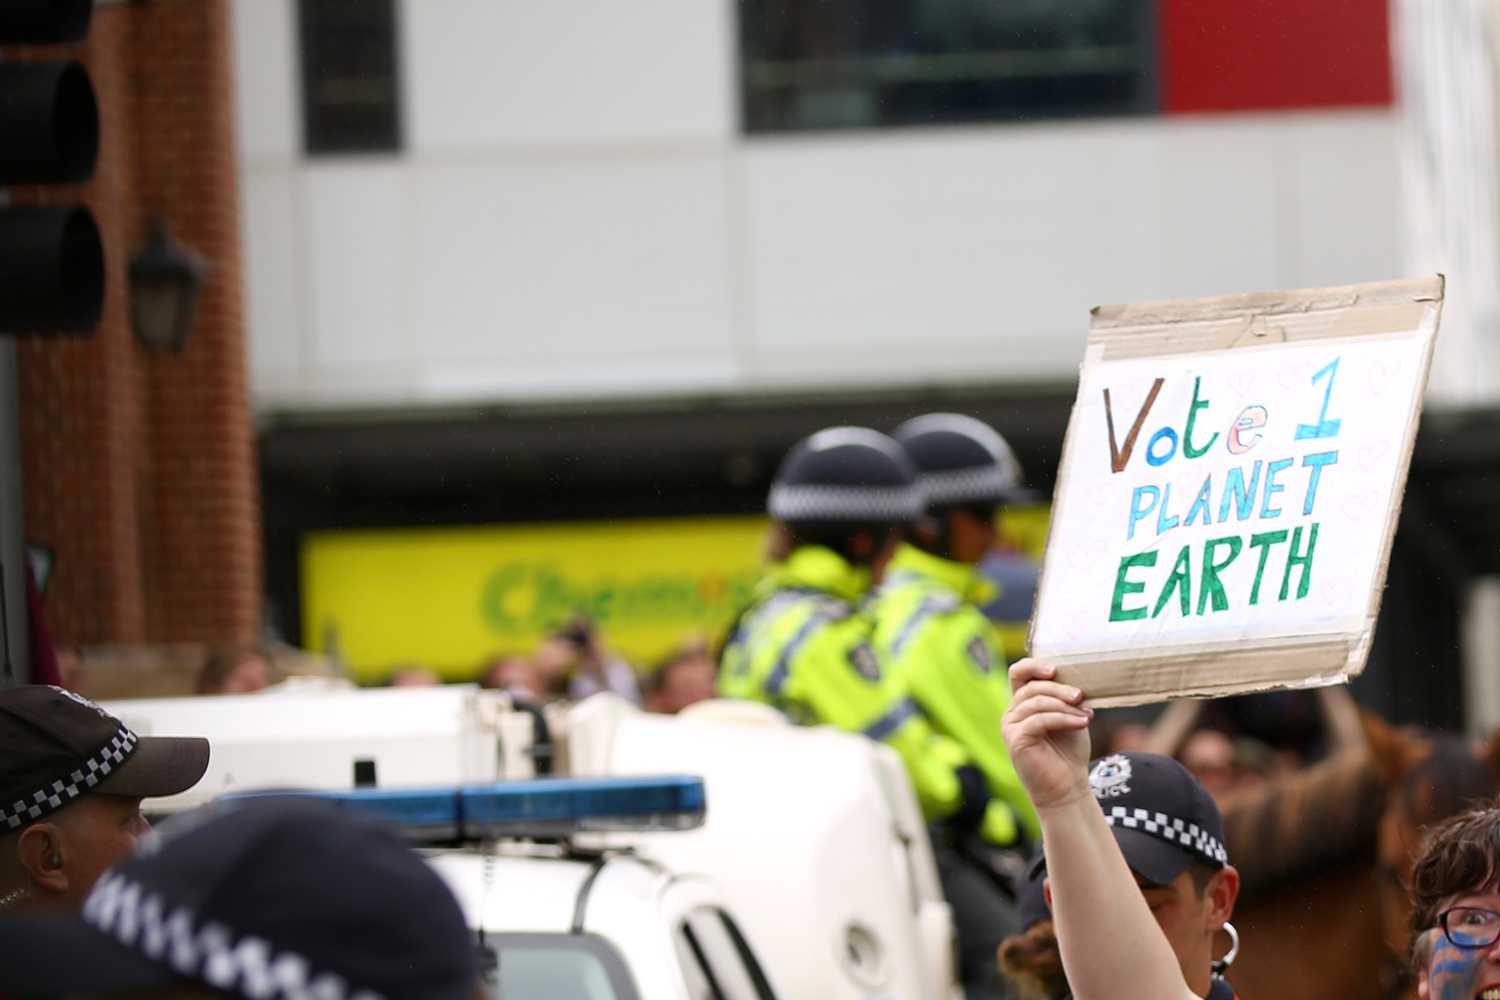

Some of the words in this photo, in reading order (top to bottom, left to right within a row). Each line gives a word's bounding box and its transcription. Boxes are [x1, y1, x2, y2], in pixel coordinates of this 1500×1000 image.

[1103, 376, 1268, 474] Vote
[1294, 356, 1342, 441] 1
[1127, 449, 1339, 541] PLANET
[1109, 522, 1321, 622] EARTH
